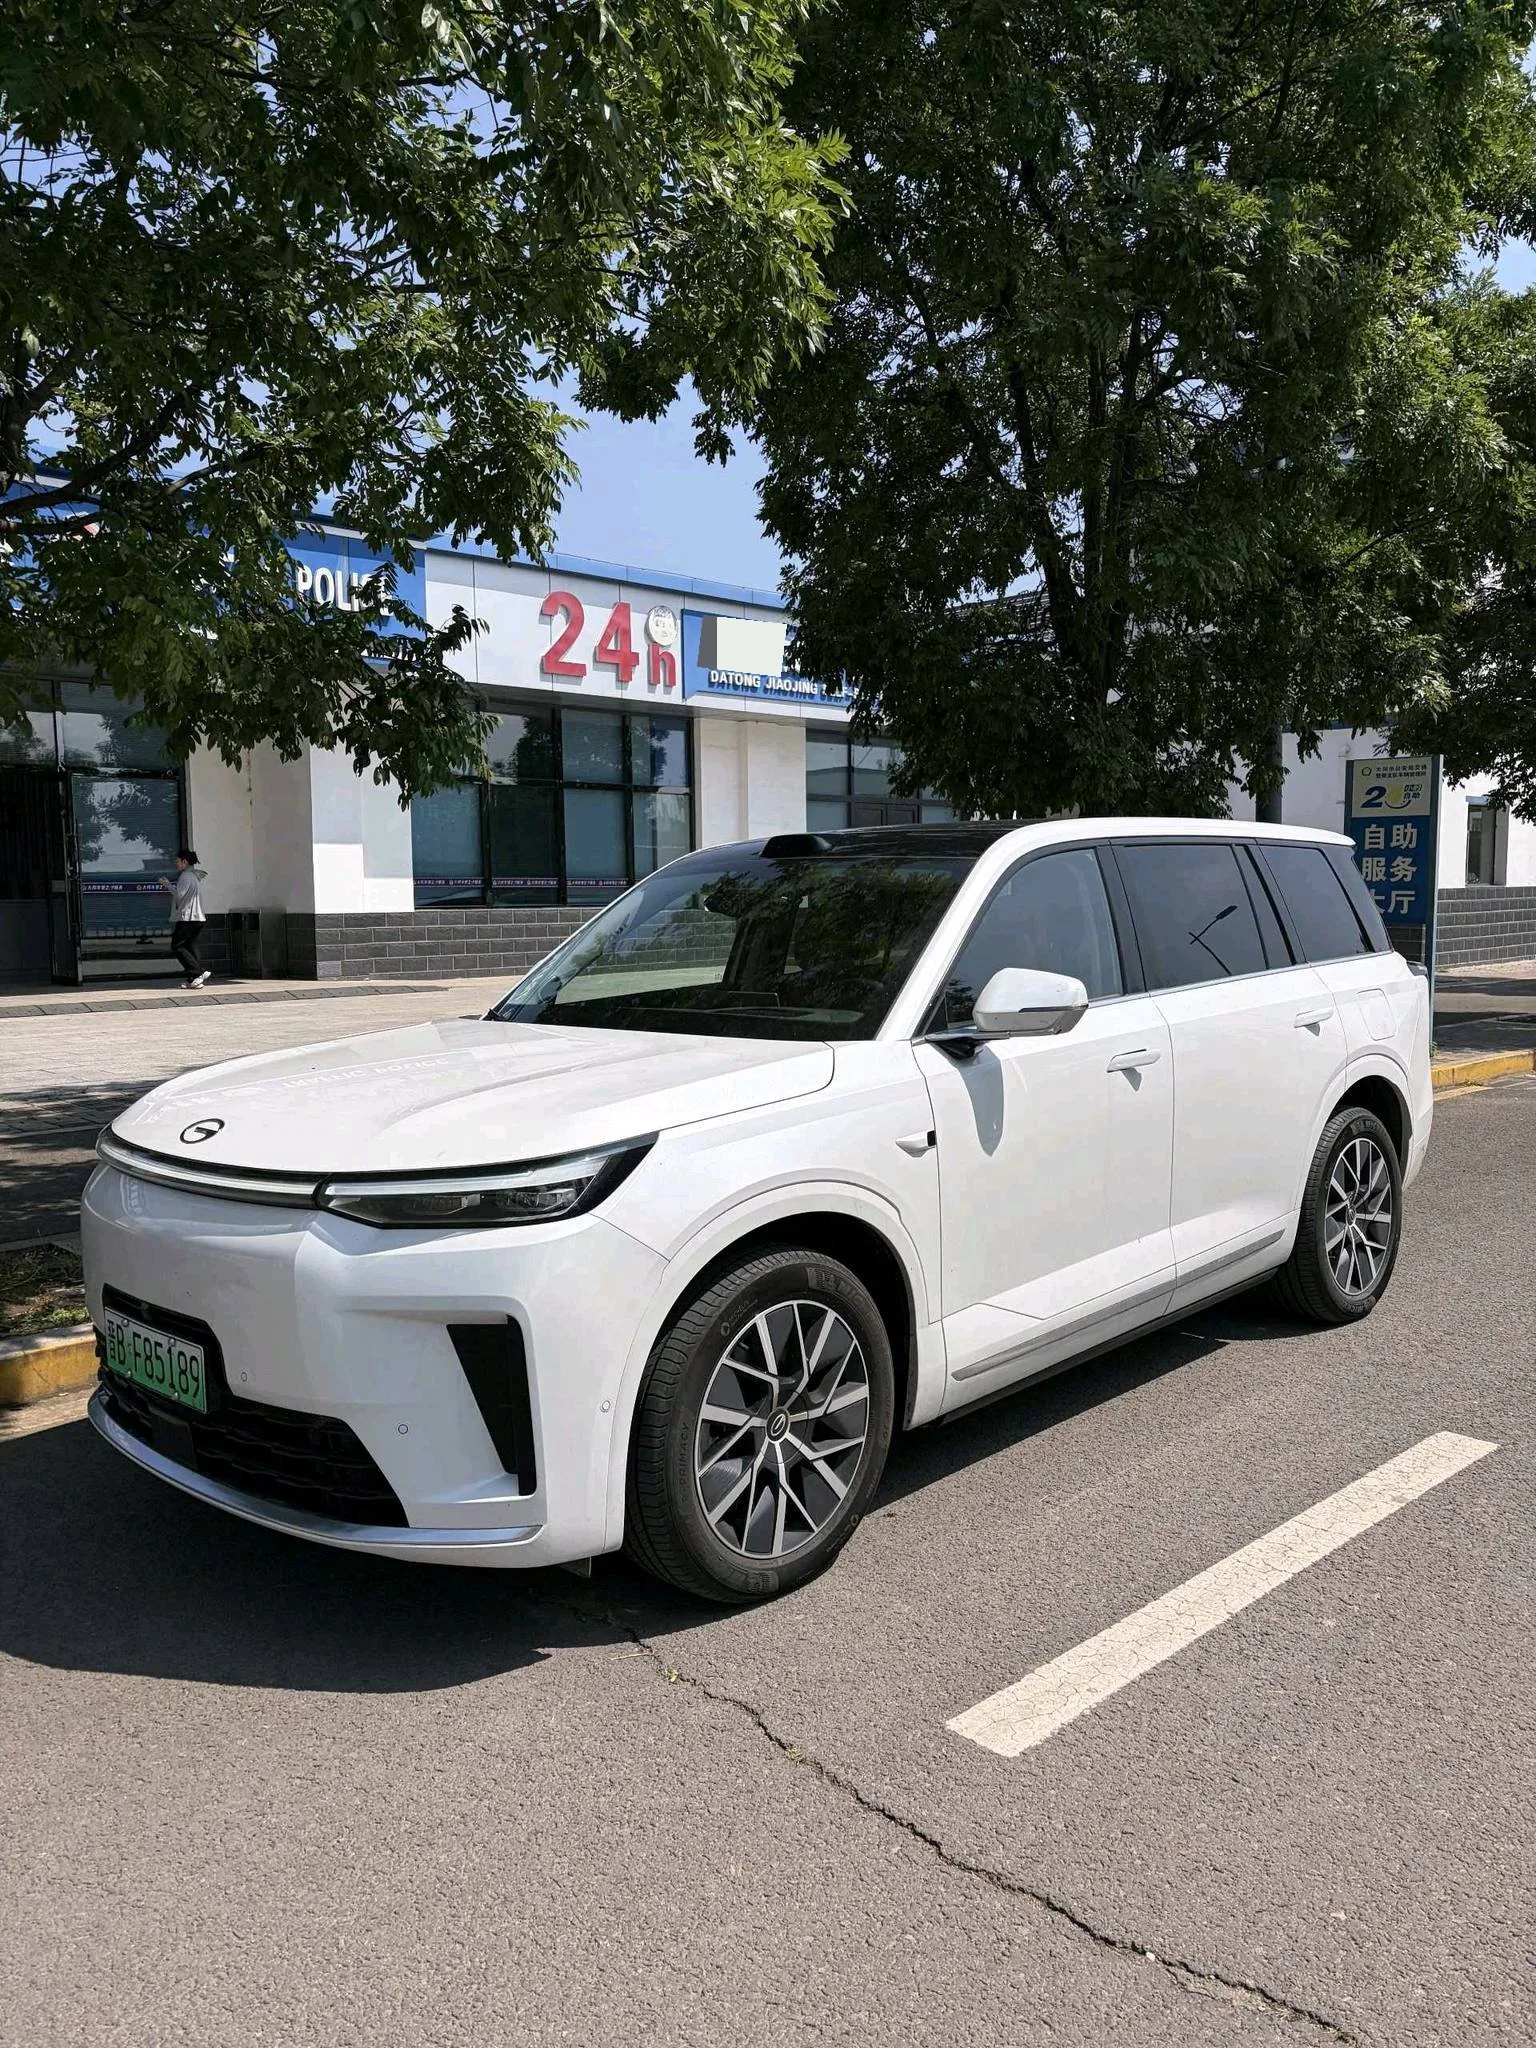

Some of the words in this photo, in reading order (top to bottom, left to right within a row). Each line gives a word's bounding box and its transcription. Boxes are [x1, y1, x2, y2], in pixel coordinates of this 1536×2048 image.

[710, 670, 761, 688] DATONG
[766, 676, 818, 695] JIAOJING
[1364, 823, 1417, 850] 自助
[1362, 856, 1417, 882] 服务
